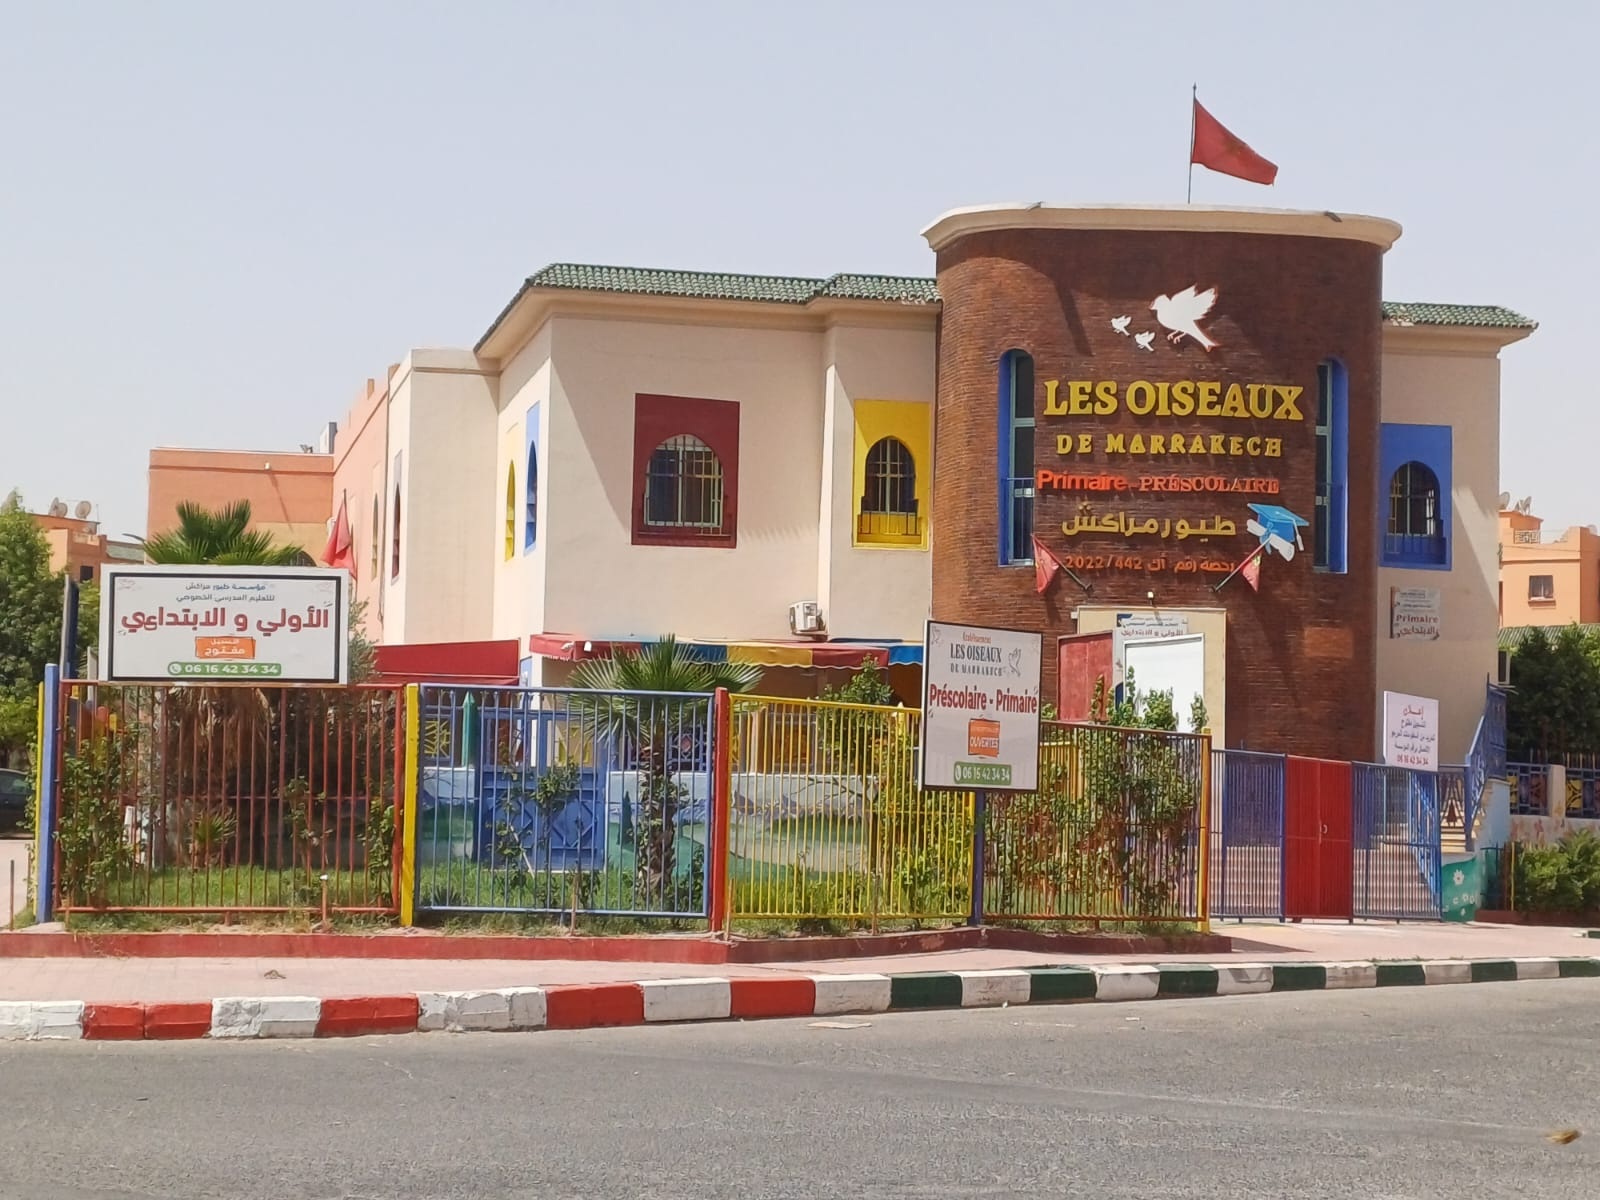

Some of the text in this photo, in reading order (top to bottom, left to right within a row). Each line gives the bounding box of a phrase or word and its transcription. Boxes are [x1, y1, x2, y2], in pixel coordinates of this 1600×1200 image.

[1043, 380, 1304, 421] LES OISEAUX
[1056, 433, 1282, 457] DE MARRAKECH
[1037, 469, 1128, 492] Primaire
[1139, 474, 1280, 495] PRÉSCOLAIRE
[1061, 502, 1237, 542] طيور مراكش
[234, 611, 248, 632] و
[256, 605, 329, 637] الأولي
[1396, 614, 1439, 623] Primaire
[950, 643, 1002, 663] LES OISEAUX
[184, 664, 278, 674] 06 16 42 34 34
[929, 683, 987, 711] Préscolaire
[996, 688, 1038, 713] Primaire
